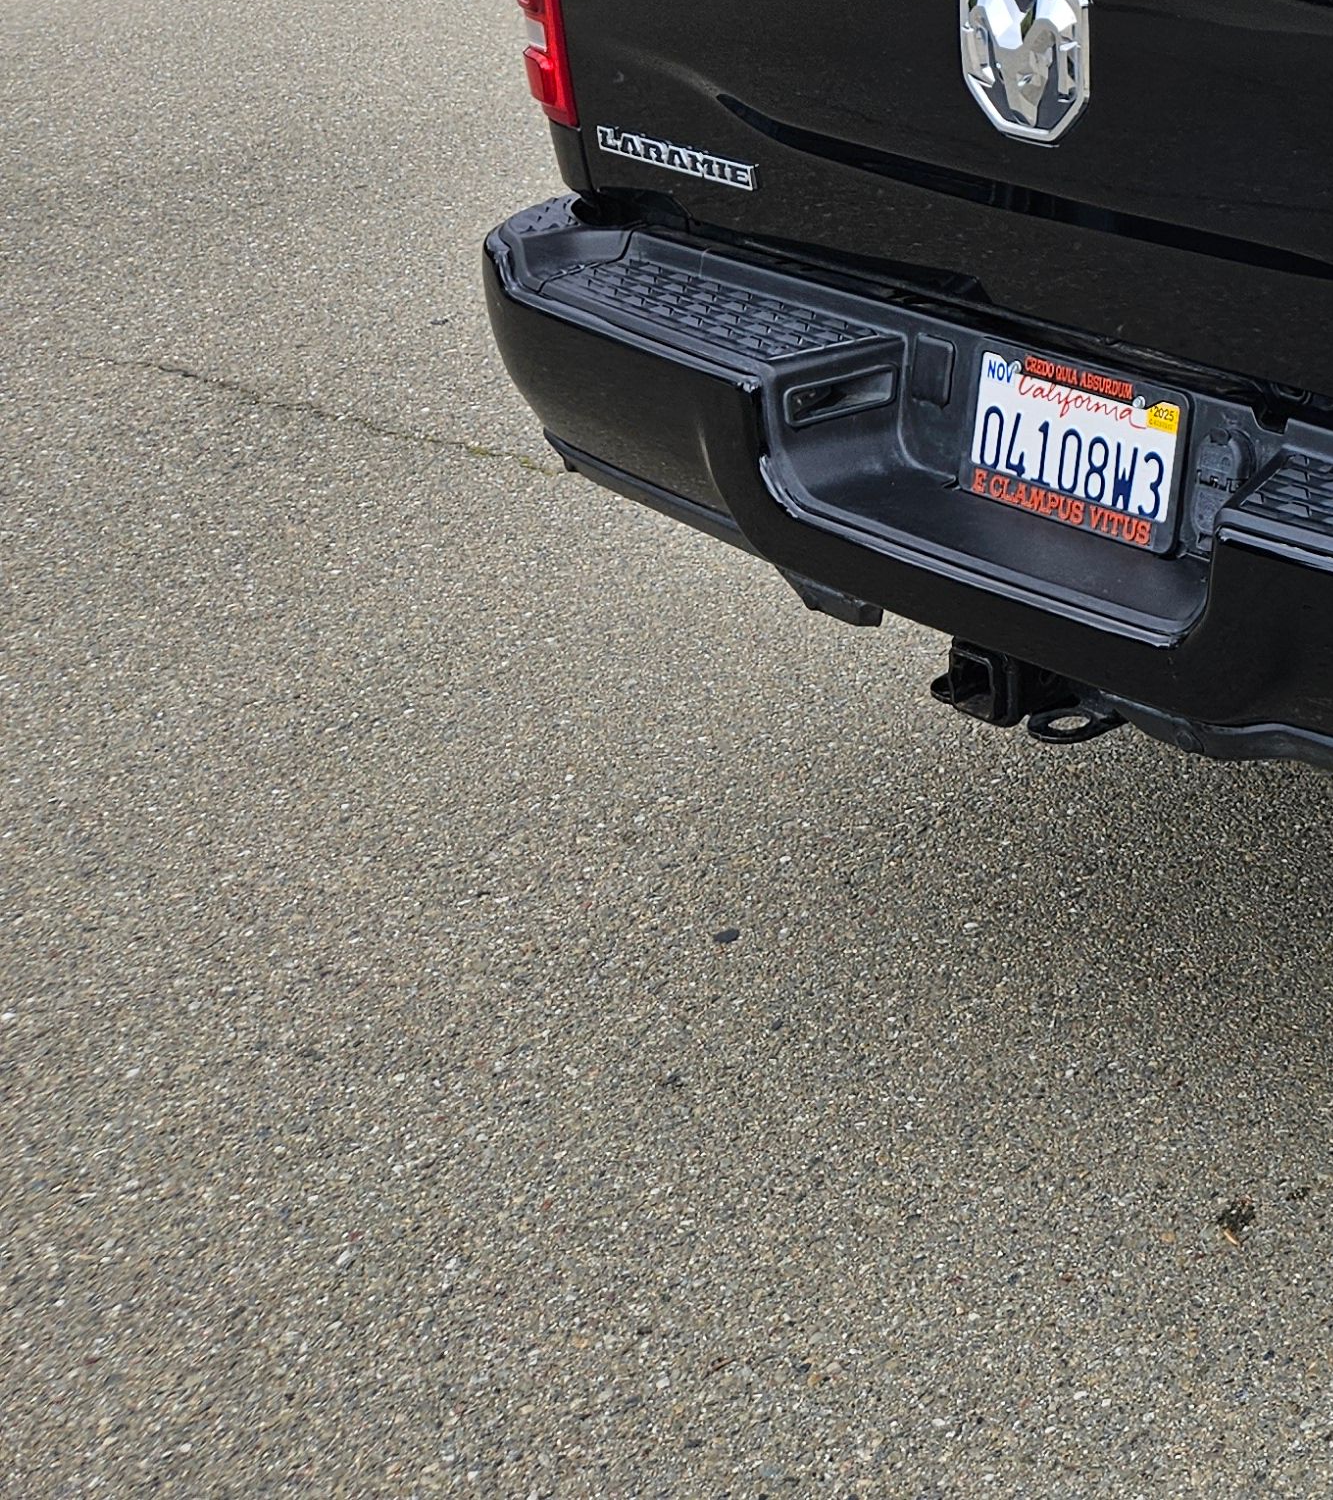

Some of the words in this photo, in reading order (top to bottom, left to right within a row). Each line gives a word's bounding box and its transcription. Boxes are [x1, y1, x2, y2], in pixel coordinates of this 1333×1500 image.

[597, 124, 758, 192] LARAMIE
[987, 359, 1013, 383] NOV
[1024, 355, 1055, 379] CREDO
[1056, 364, 1077, 384] QUIA
[1080, 371, 1134, 400] ABSURDUM
[1018, 374, 1147, 430] California
[1153, 405, 1175, 422] 2025
[979, 406, 1164, 520] 04108W3
[972, 469, 986, 494] E
[989, 475, 1085, 526] CLAMPUS
[1089, 507, 1151, 547] VITUS
